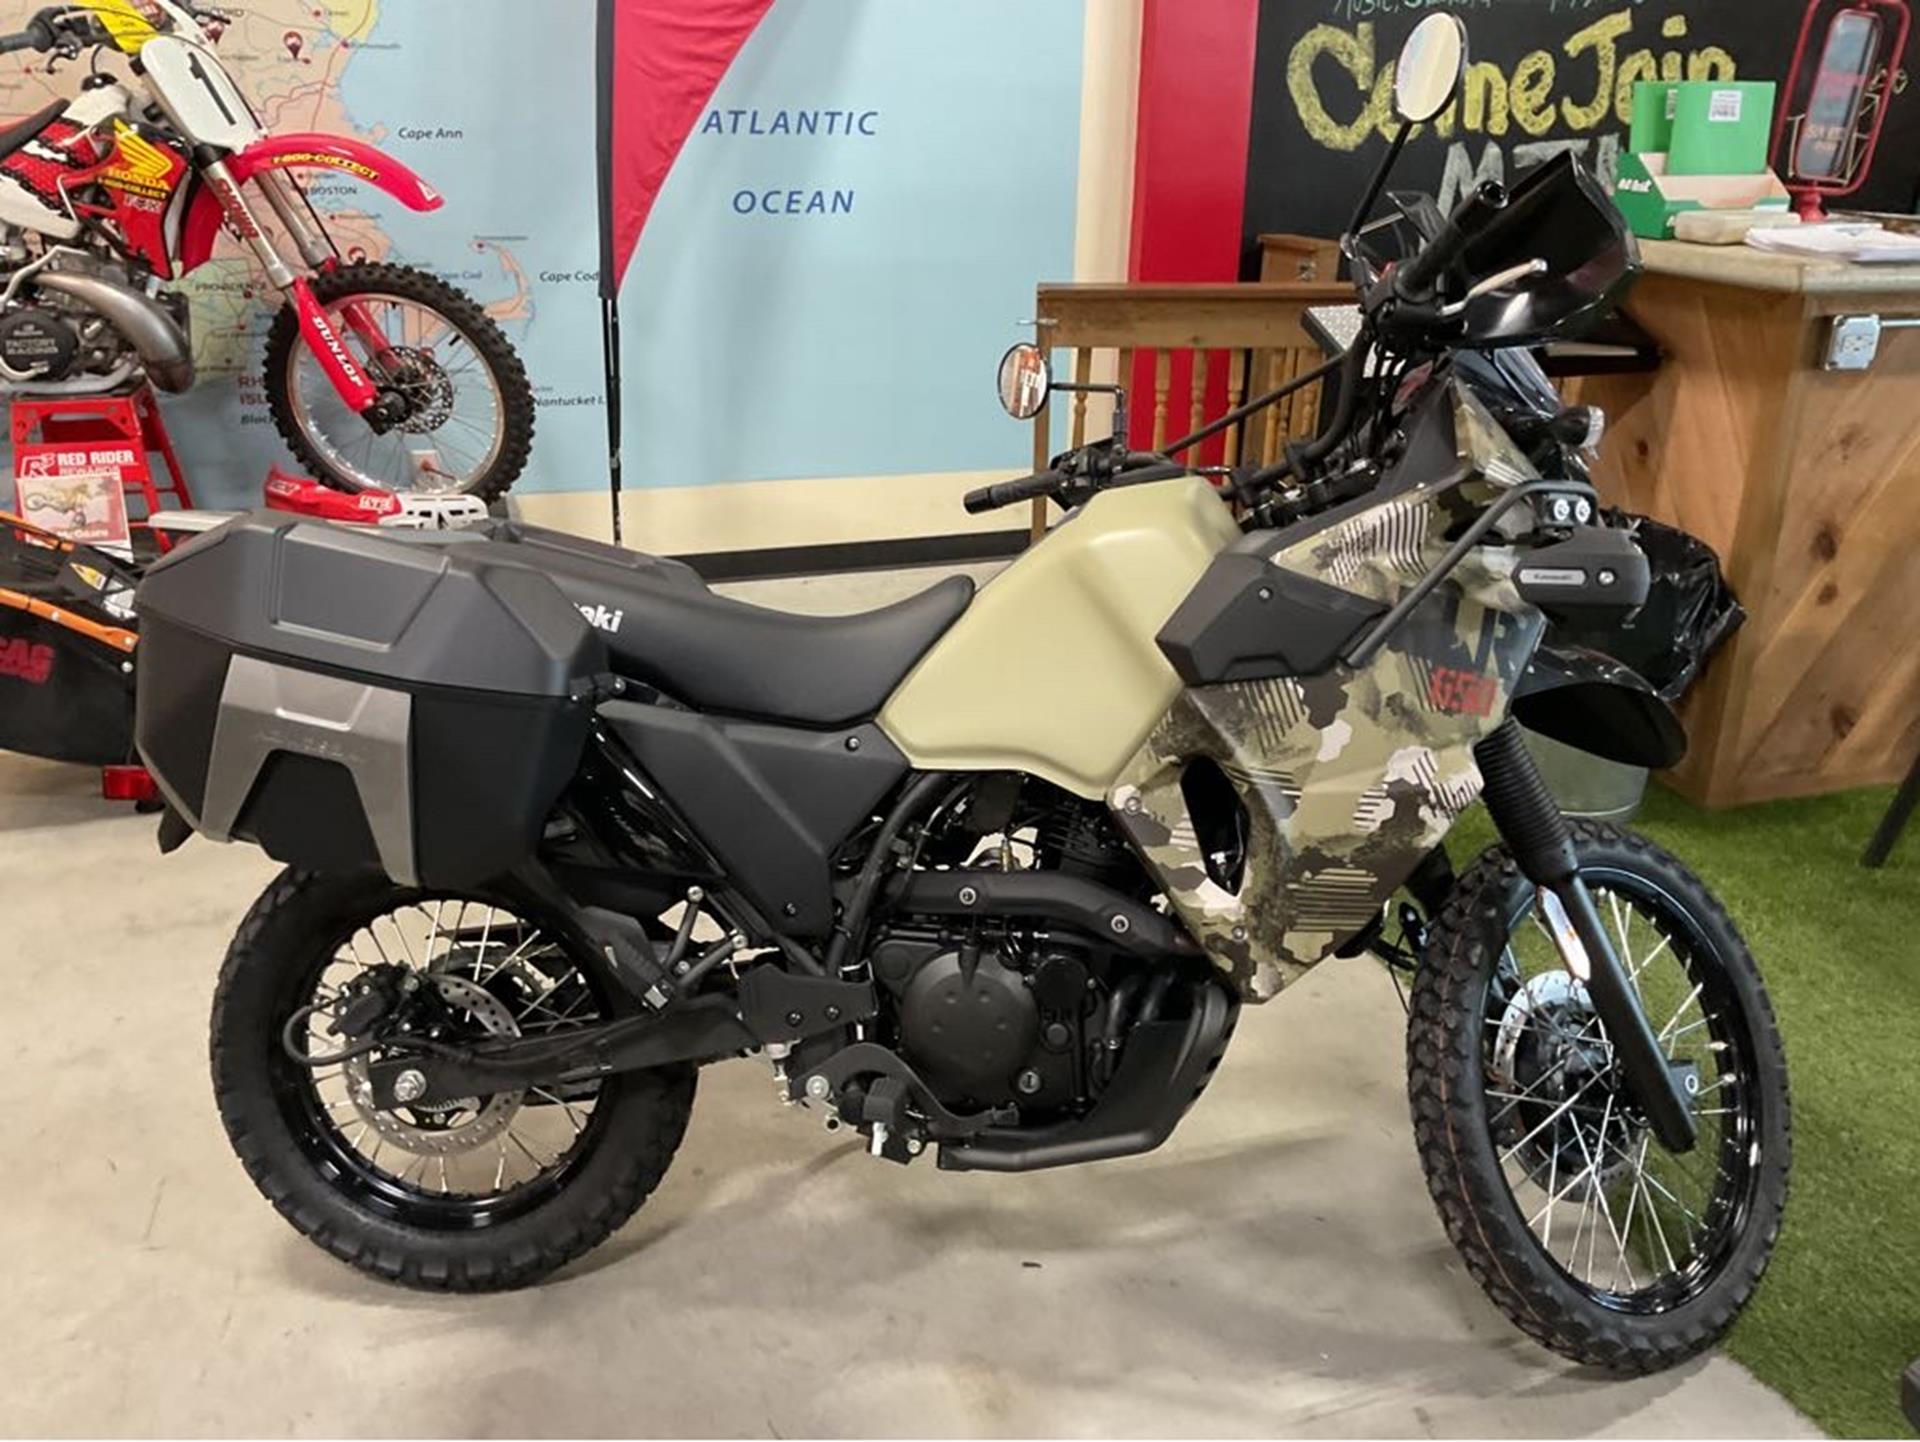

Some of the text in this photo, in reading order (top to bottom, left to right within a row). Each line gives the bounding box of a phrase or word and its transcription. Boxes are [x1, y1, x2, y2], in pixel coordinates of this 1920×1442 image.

[187, 51, 236, 125] 1
[702, 110, 878, 135] ATLANTIC
[398, 127, 463, 140] Cape Ann
[310, 186, 357, 196] BOSTON
[732, 190, 854, 214] OCEAN
[540, 270, 600, 283] Cape Cod
[312, 315, 364, 387] DUNLOP
[57, 450, 135, 466] RED RIDER
